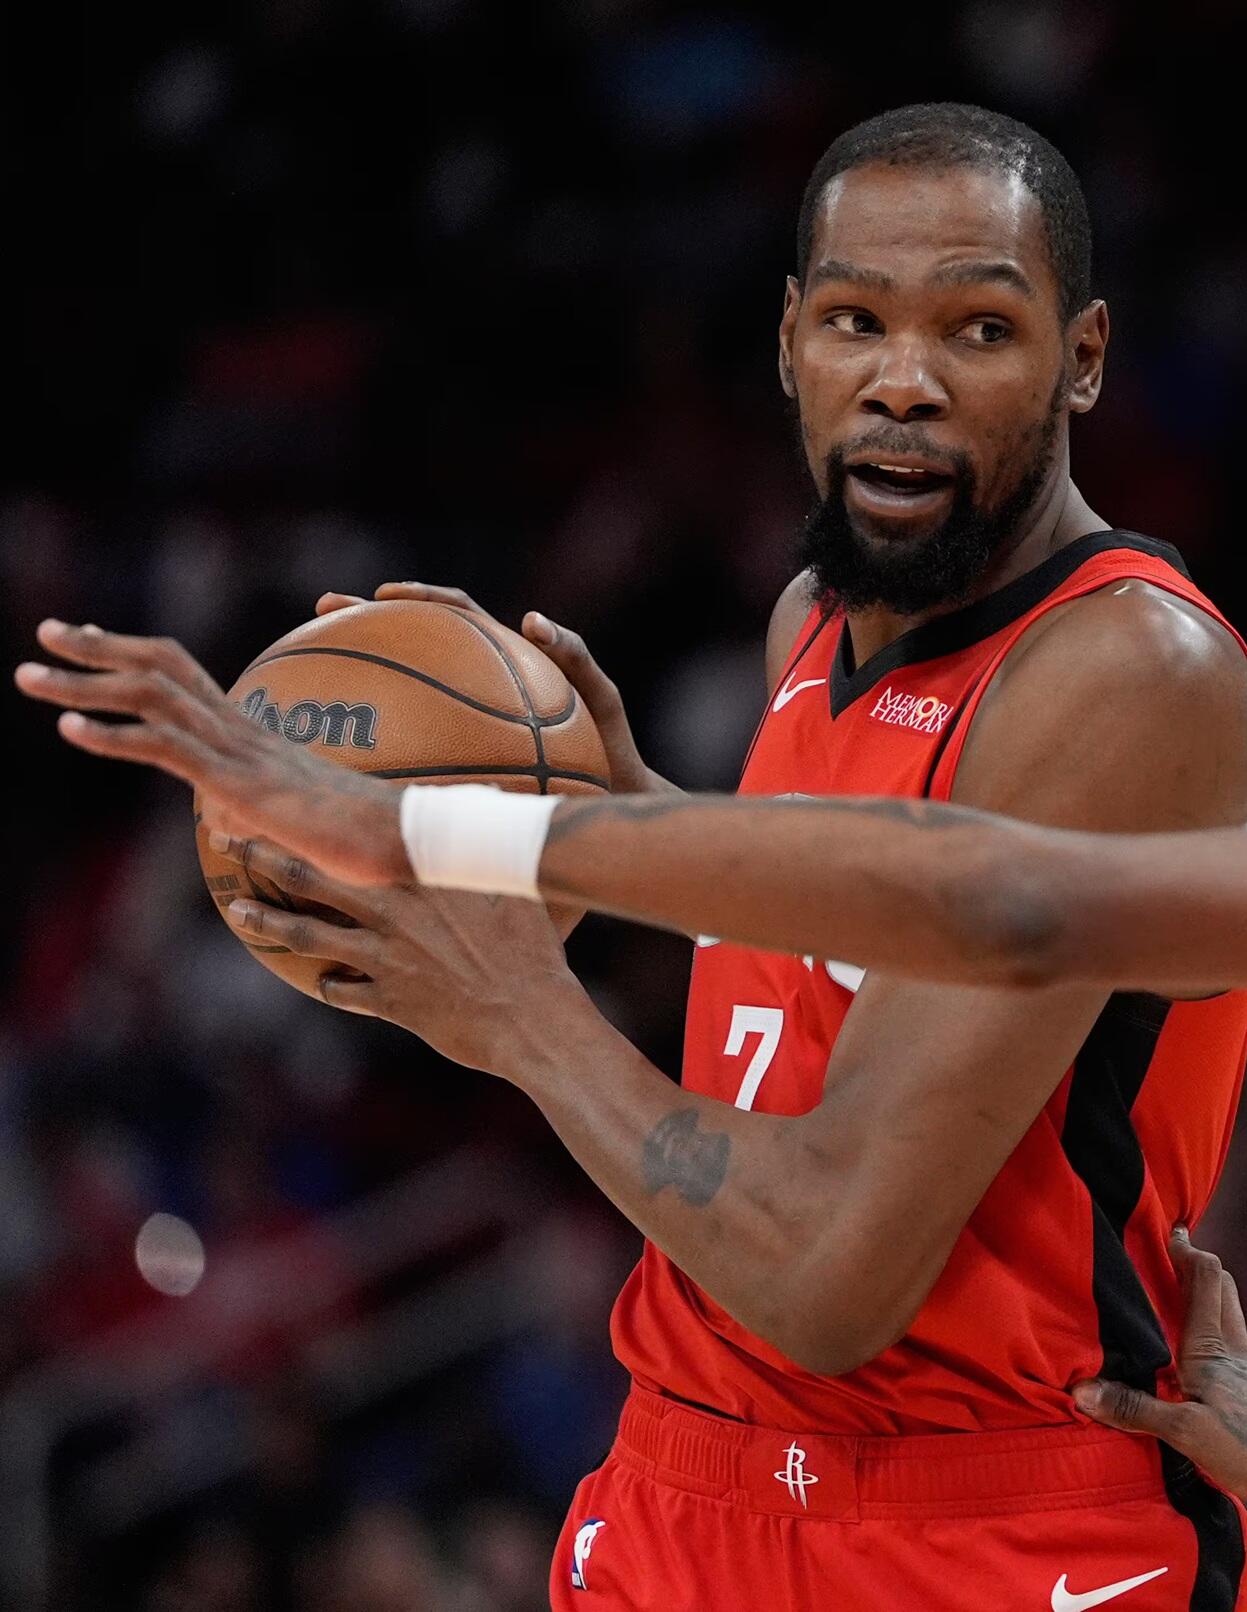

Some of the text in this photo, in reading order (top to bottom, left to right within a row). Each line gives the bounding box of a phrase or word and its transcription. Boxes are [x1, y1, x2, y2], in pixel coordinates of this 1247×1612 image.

[242, 687, 376, 750] lson
[878, 686, 954, 721] MEMORI
[723, 1004, 784, 1112] 7
